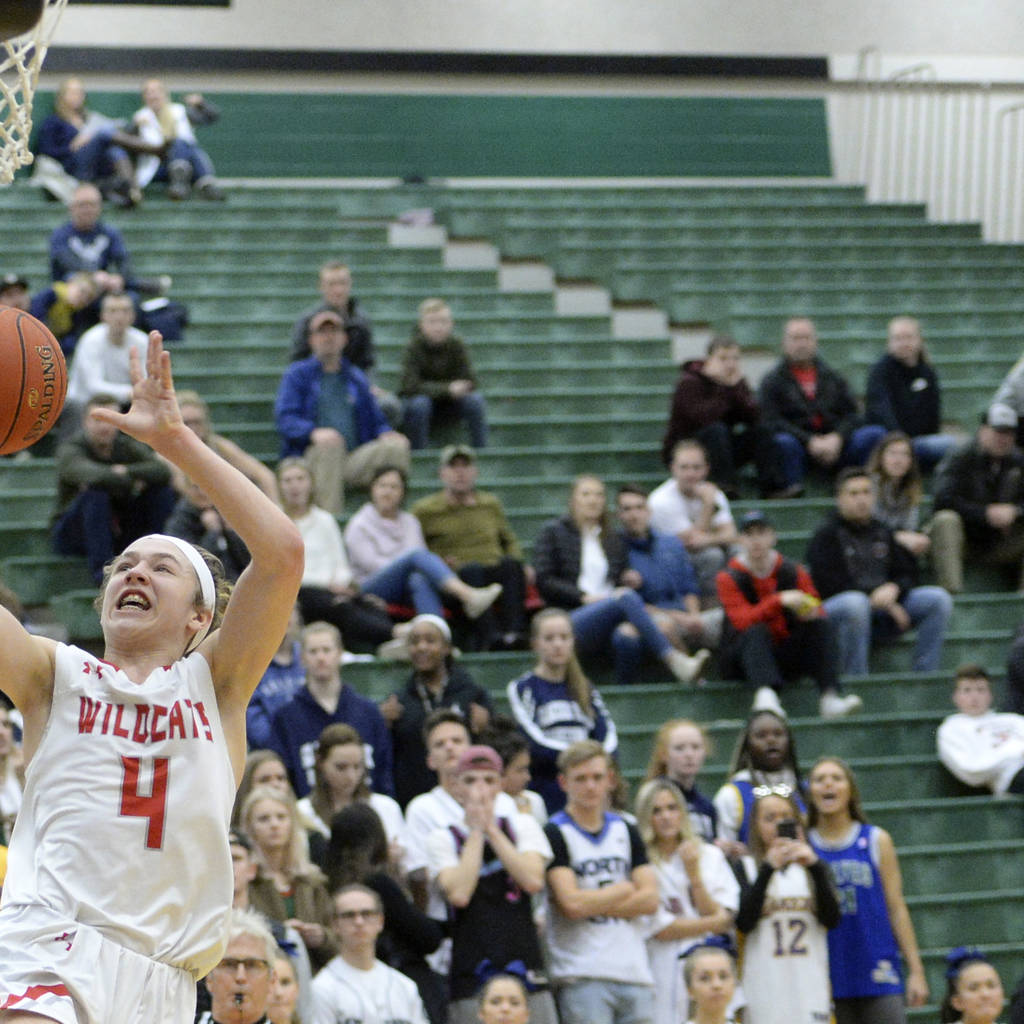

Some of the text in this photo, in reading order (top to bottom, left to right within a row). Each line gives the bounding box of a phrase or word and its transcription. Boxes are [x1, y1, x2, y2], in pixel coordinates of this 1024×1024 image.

[22, 345, 56, 442] SPALDING
[78, 696, 214, 744] WILDCATS
[118, 754, 172, 852] 4
[773, 918, 808, 957] 12
